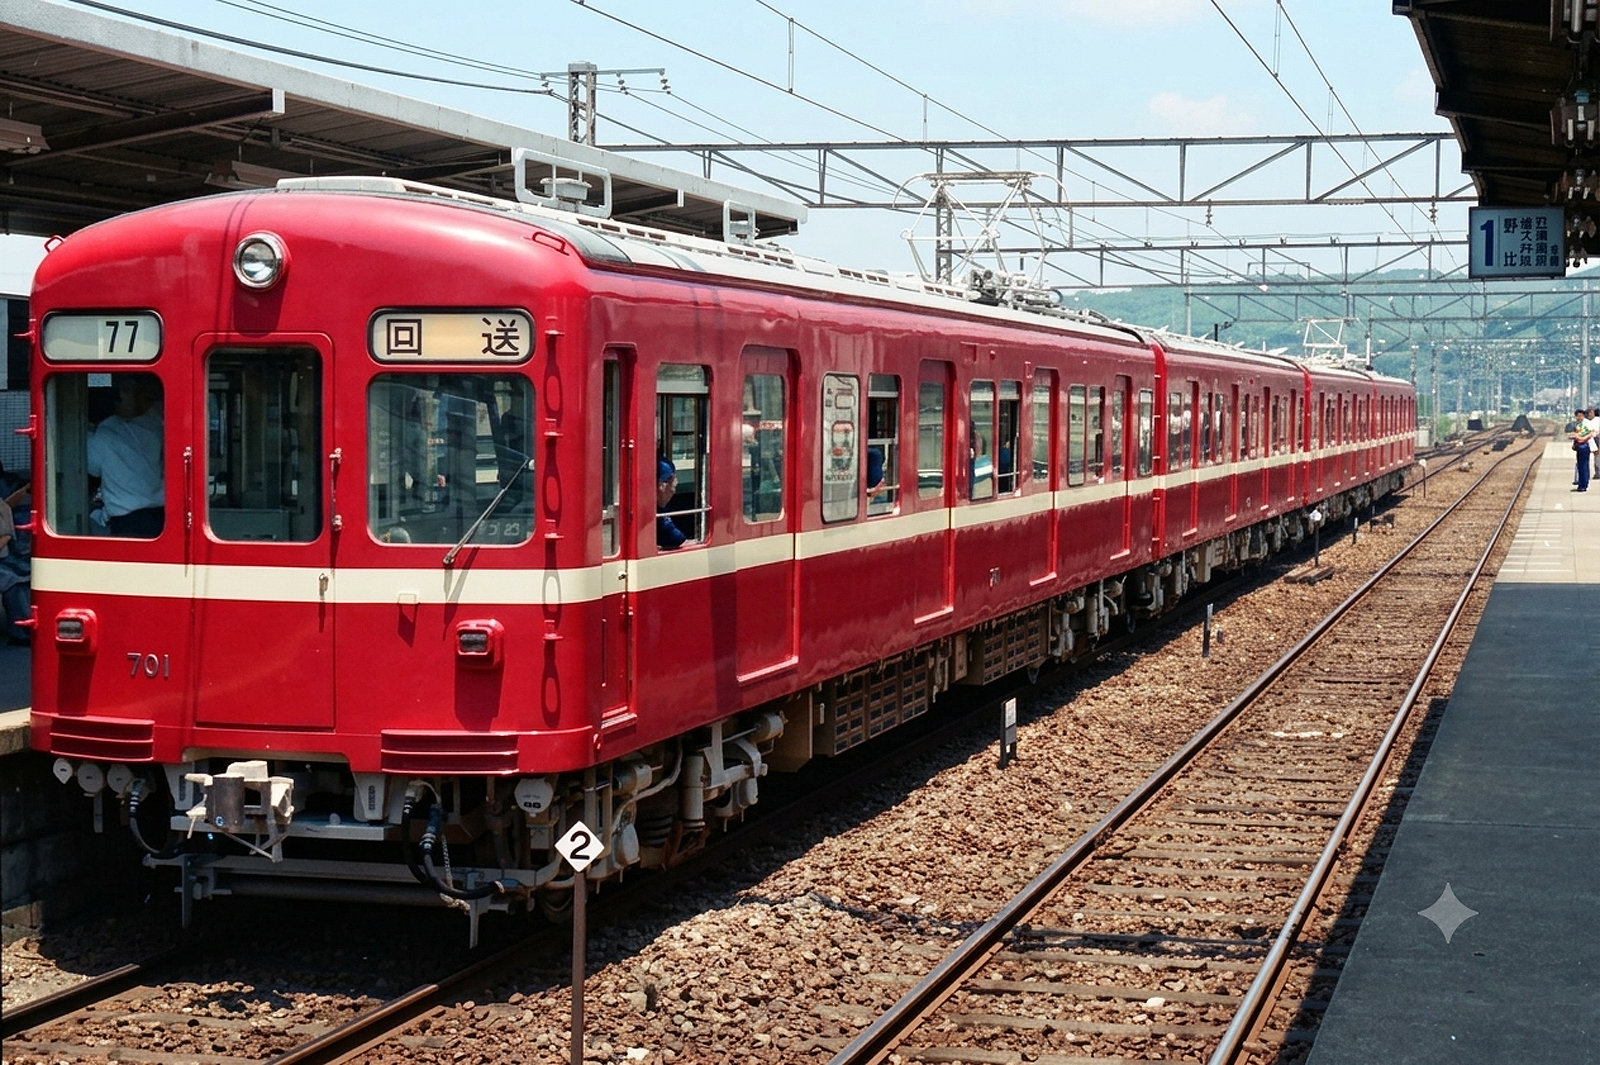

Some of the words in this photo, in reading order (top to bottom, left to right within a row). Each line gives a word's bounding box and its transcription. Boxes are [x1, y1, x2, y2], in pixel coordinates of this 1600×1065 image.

[1480, 219, 1494, 267] 1
[106, 320, 140, 354] 77
[386, 318, 520, 357] 回送
[127, 652, 170, 677] 701
[569, 830, 591, 860] 2
